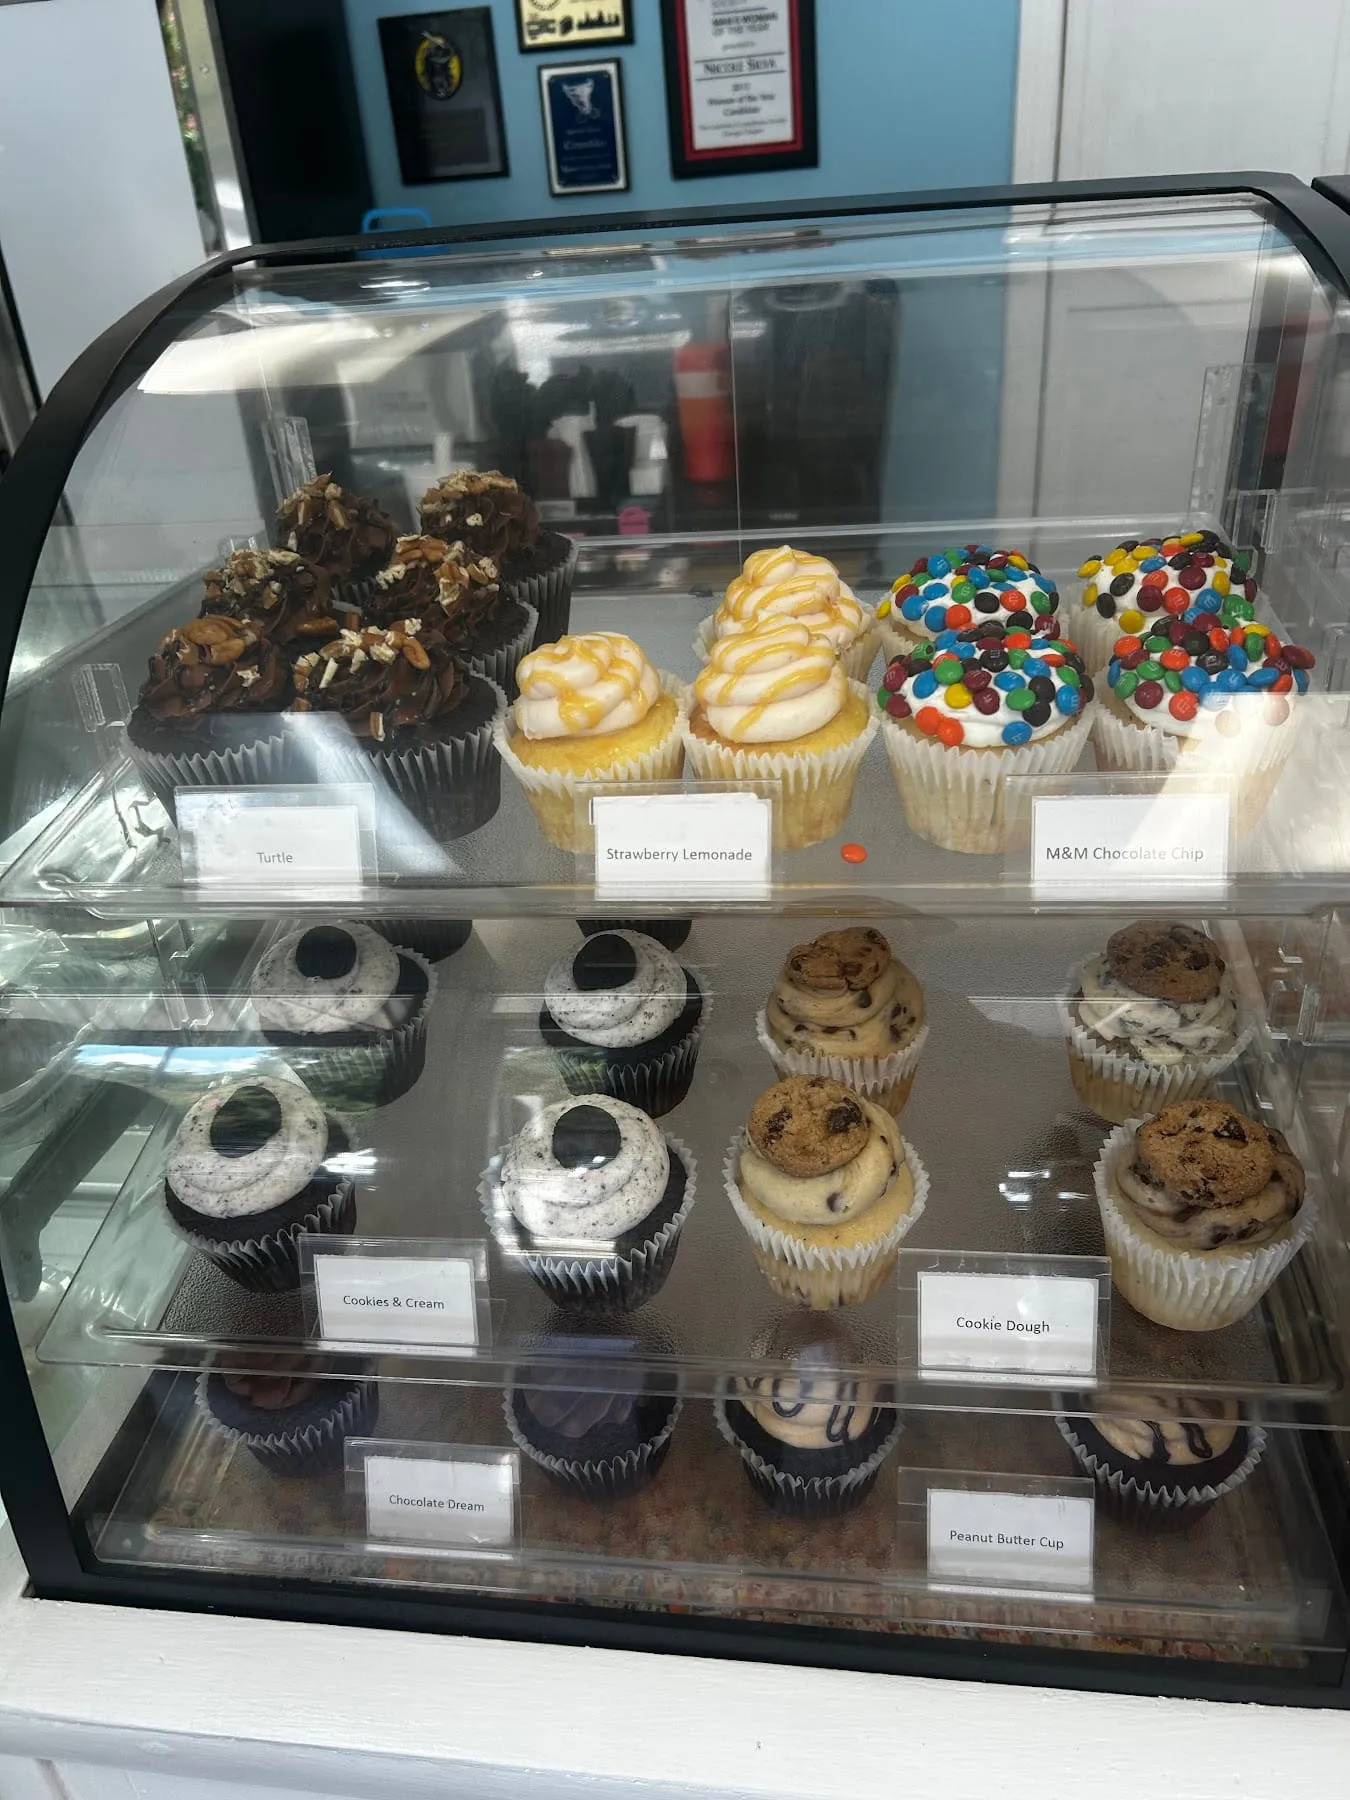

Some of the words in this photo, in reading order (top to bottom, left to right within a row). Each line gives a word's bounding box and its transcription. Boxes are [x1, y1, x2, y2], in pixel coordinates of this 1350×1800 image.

[256, 851, 294, 864] Turtle
[606, 847, 679, 863] Strawberry
[683, 848, 753, 861] Lemonade
[1046, 846, 1089, 861] M&M
[1093, 846, 1167, 861] Chocolate
[1171, 846, 1205, 863] Chip
[343, 1295, 389, 1308] Cookies
[392, 1297, 402, 1308] &
[405, 1298, 445, 1310] Cream
[956, 1316, 1002, 1331] Cookie
[1006, 1320, 1050, 1335] Dough
[389, 1494, 445, 1509] Chocolate
[448, 1499, 485, 1512] Dream
[950, 1530, 993, 1544] Peanut
[997, 1533, 1036, 1547] Butter
[1039, 1536, 1065, 1551] Cup
